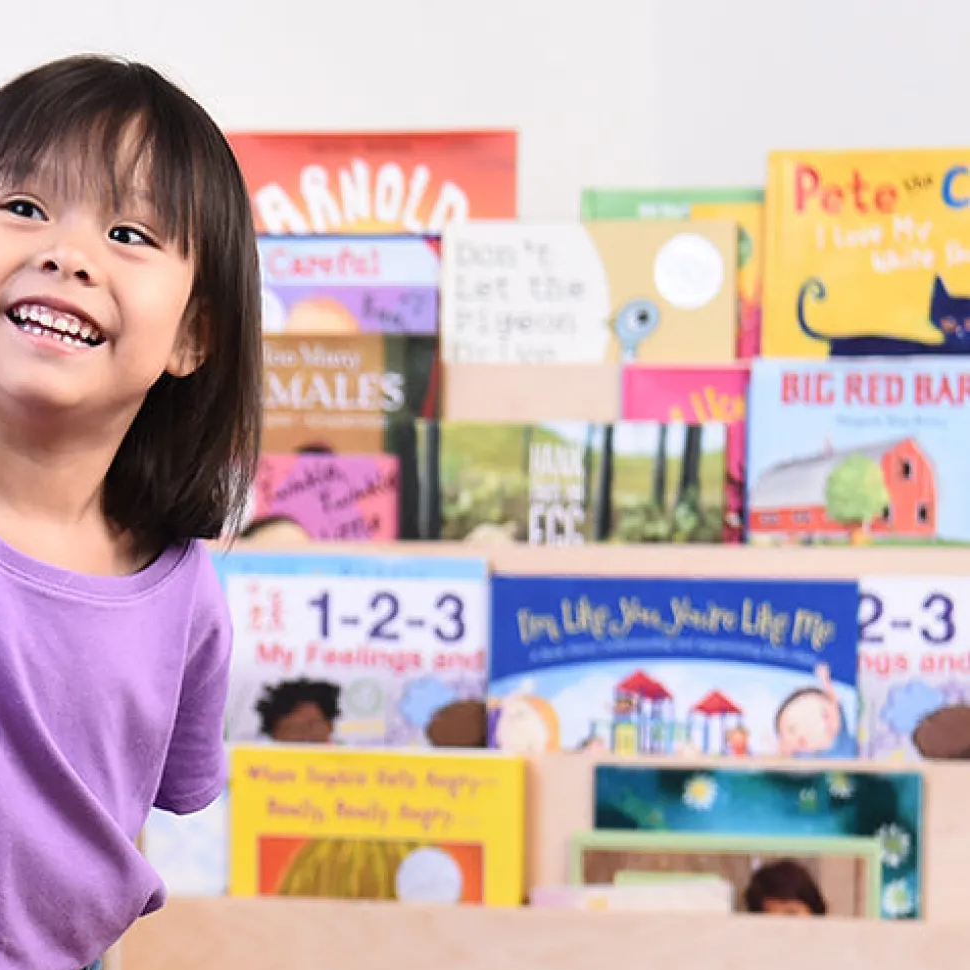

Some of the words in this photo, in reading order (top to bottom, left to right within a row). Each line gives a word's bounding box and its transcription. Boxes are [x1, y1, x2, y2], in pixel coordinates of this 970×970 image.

[794, 161, 899, 215] Pete
[834, 223, 883, 248] Love
[892, 213, 932, 244] My
[456, 274, 509, 302] Let
[530, 275, 586, 302] the
[264, 371, 405, 412] MALES
[781, 372, 836, 406] BIG
[844, 372, 905, 406] RED
[309, 591, 466, 642] 1-2-3
[561, 594, 611, 641] Like
[741, 597, 791, 648] Like
[858, 592, 957, 644] 2-3
[257, 643, 294, 674] My
[305, 643, 422, 677] Feelings
[433, 649, 486, 671] and
